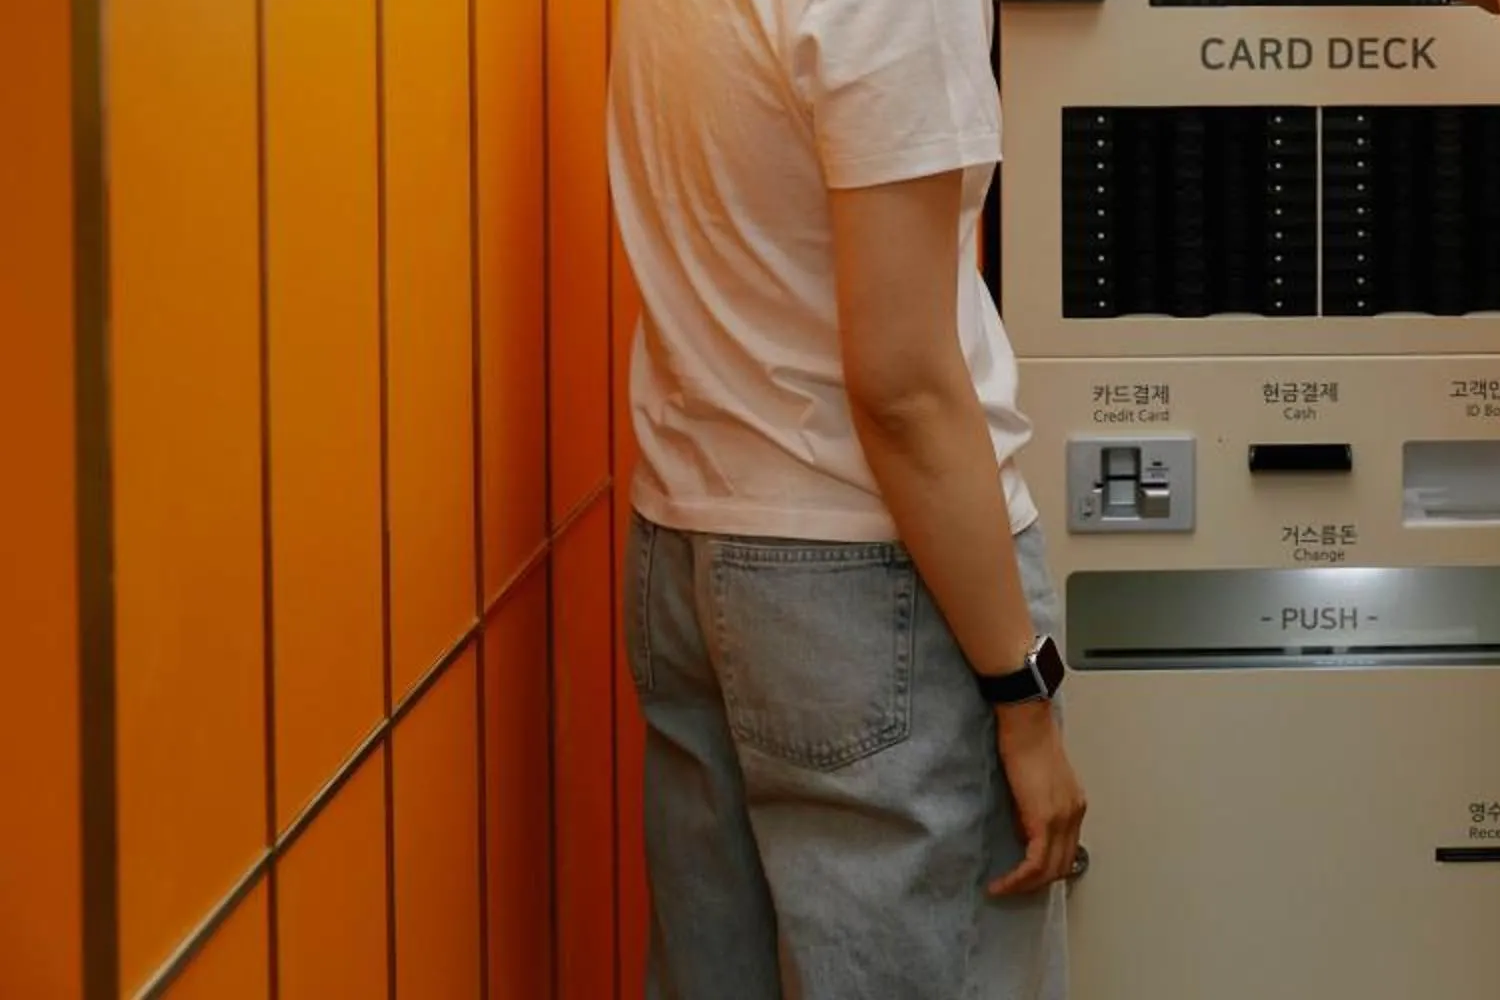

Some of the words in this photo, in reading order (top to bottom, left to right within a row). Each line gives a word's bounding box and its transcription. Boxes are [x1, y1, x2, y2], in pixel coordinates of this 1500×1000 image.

[1200, 36, 1314, 72] CARD
[1327, 36, 1438, 71] DECK
[1092, 383, 1170, 406] 카드결제
[1263, 381, 1339, 404] 현금결제
[1093, 408, 1135, 423] Credit
[1138, 408, 1170, 423] Card
[1282, 406, 1317, 421] Cash
[1466, 404, 1481, 417] ID
[1281, 524, 1358, 547] 거스름돈
[1293, 547, 1346, 563] Change
[1280, 606, 1358, 631] PUSH
